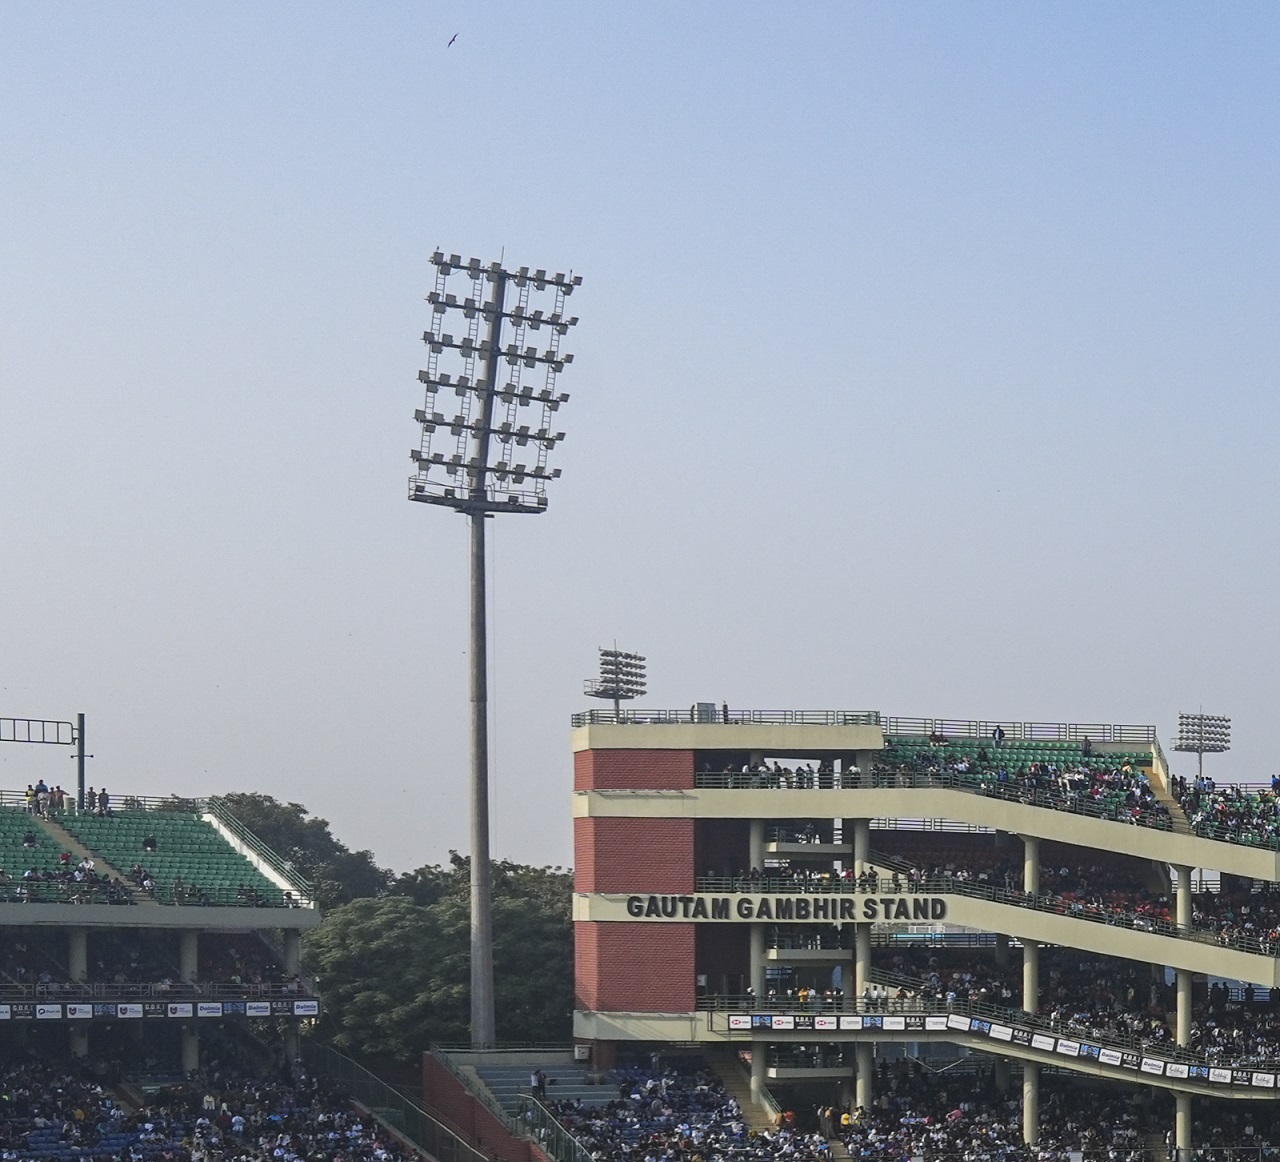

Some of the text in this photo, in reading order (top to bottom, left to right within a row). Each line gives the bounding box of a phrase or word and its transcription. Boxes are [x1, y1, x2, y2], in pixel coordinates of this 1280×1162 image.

[627, 896, 947, 920] GAUTAM GAMBHIR STAND
[1059, 1042, 1078, 1050] Dalmia
[1101, 1051, 1120, 1060] Dalmia
[1144, 1061, 1162, 1069] Dalmia
